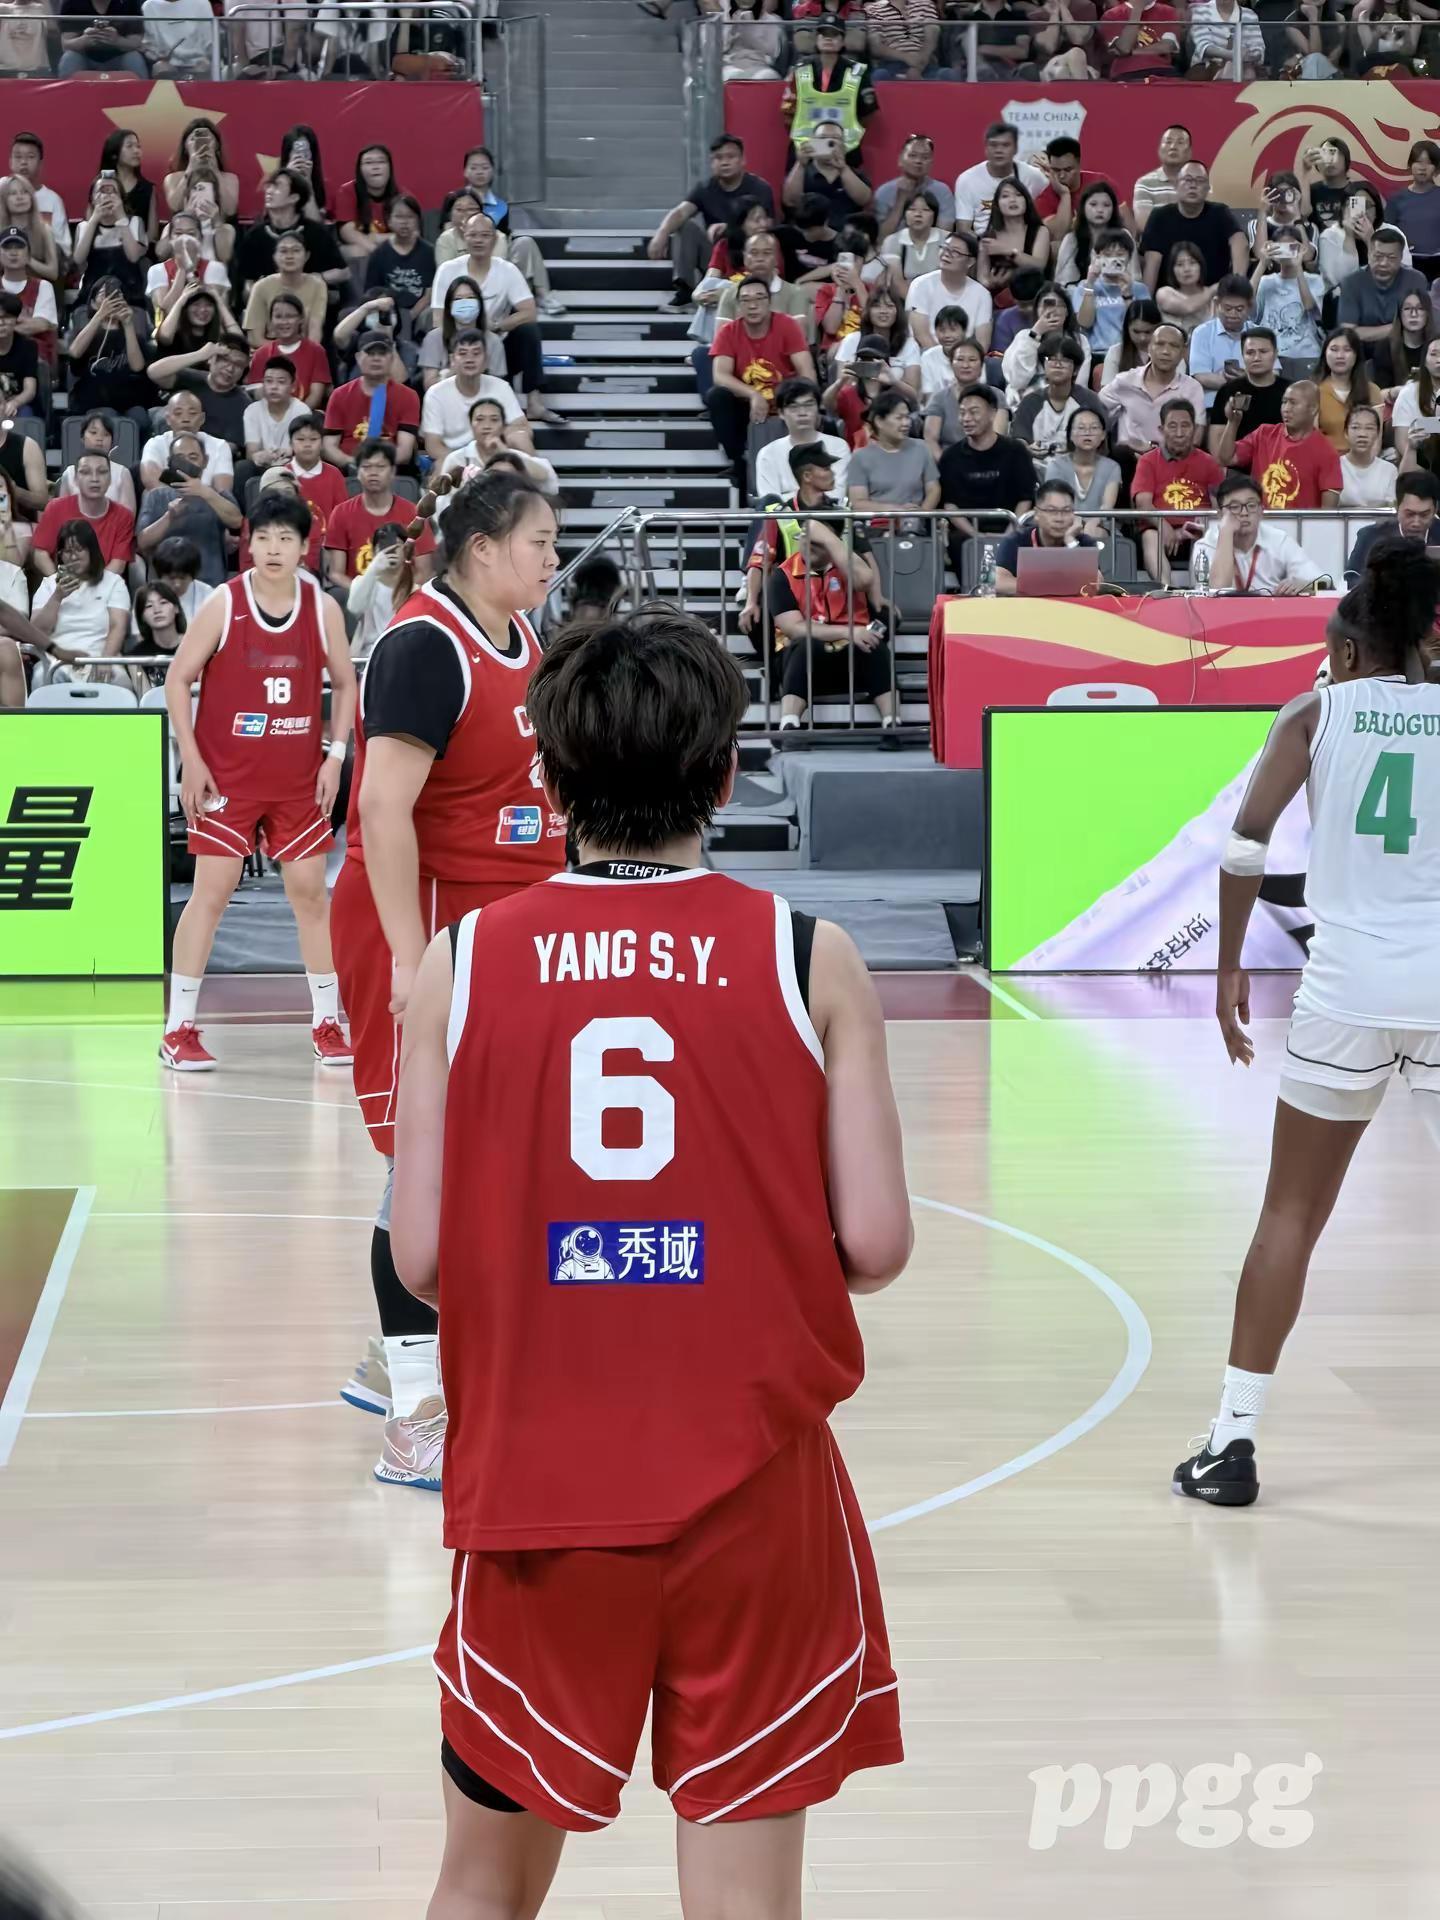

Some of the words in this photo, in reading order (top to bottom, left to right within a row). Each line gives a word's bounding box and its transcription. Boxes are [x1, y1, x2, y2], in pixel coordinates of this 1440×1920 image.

[1008, 111, 1040, 121] TEAM
[1043, 111, 1081, 121] CHINA
[262, 677, 291, 704] 18
[1353, 710, 1440, 737] BALOGU
[1355, 750, 1417, 855] 4
[0, 786, 94, 911] 量
[608, 863, 670, 878] TECHFIT
[533, 929, 637, 984] YANG
[650, 930, 728, 987] S.Y.
[1137, 912, 1212, 971] 运动饮
[570, 1016, 675, 1181] 6
[617, 1226, 699, 1280] 秀域
